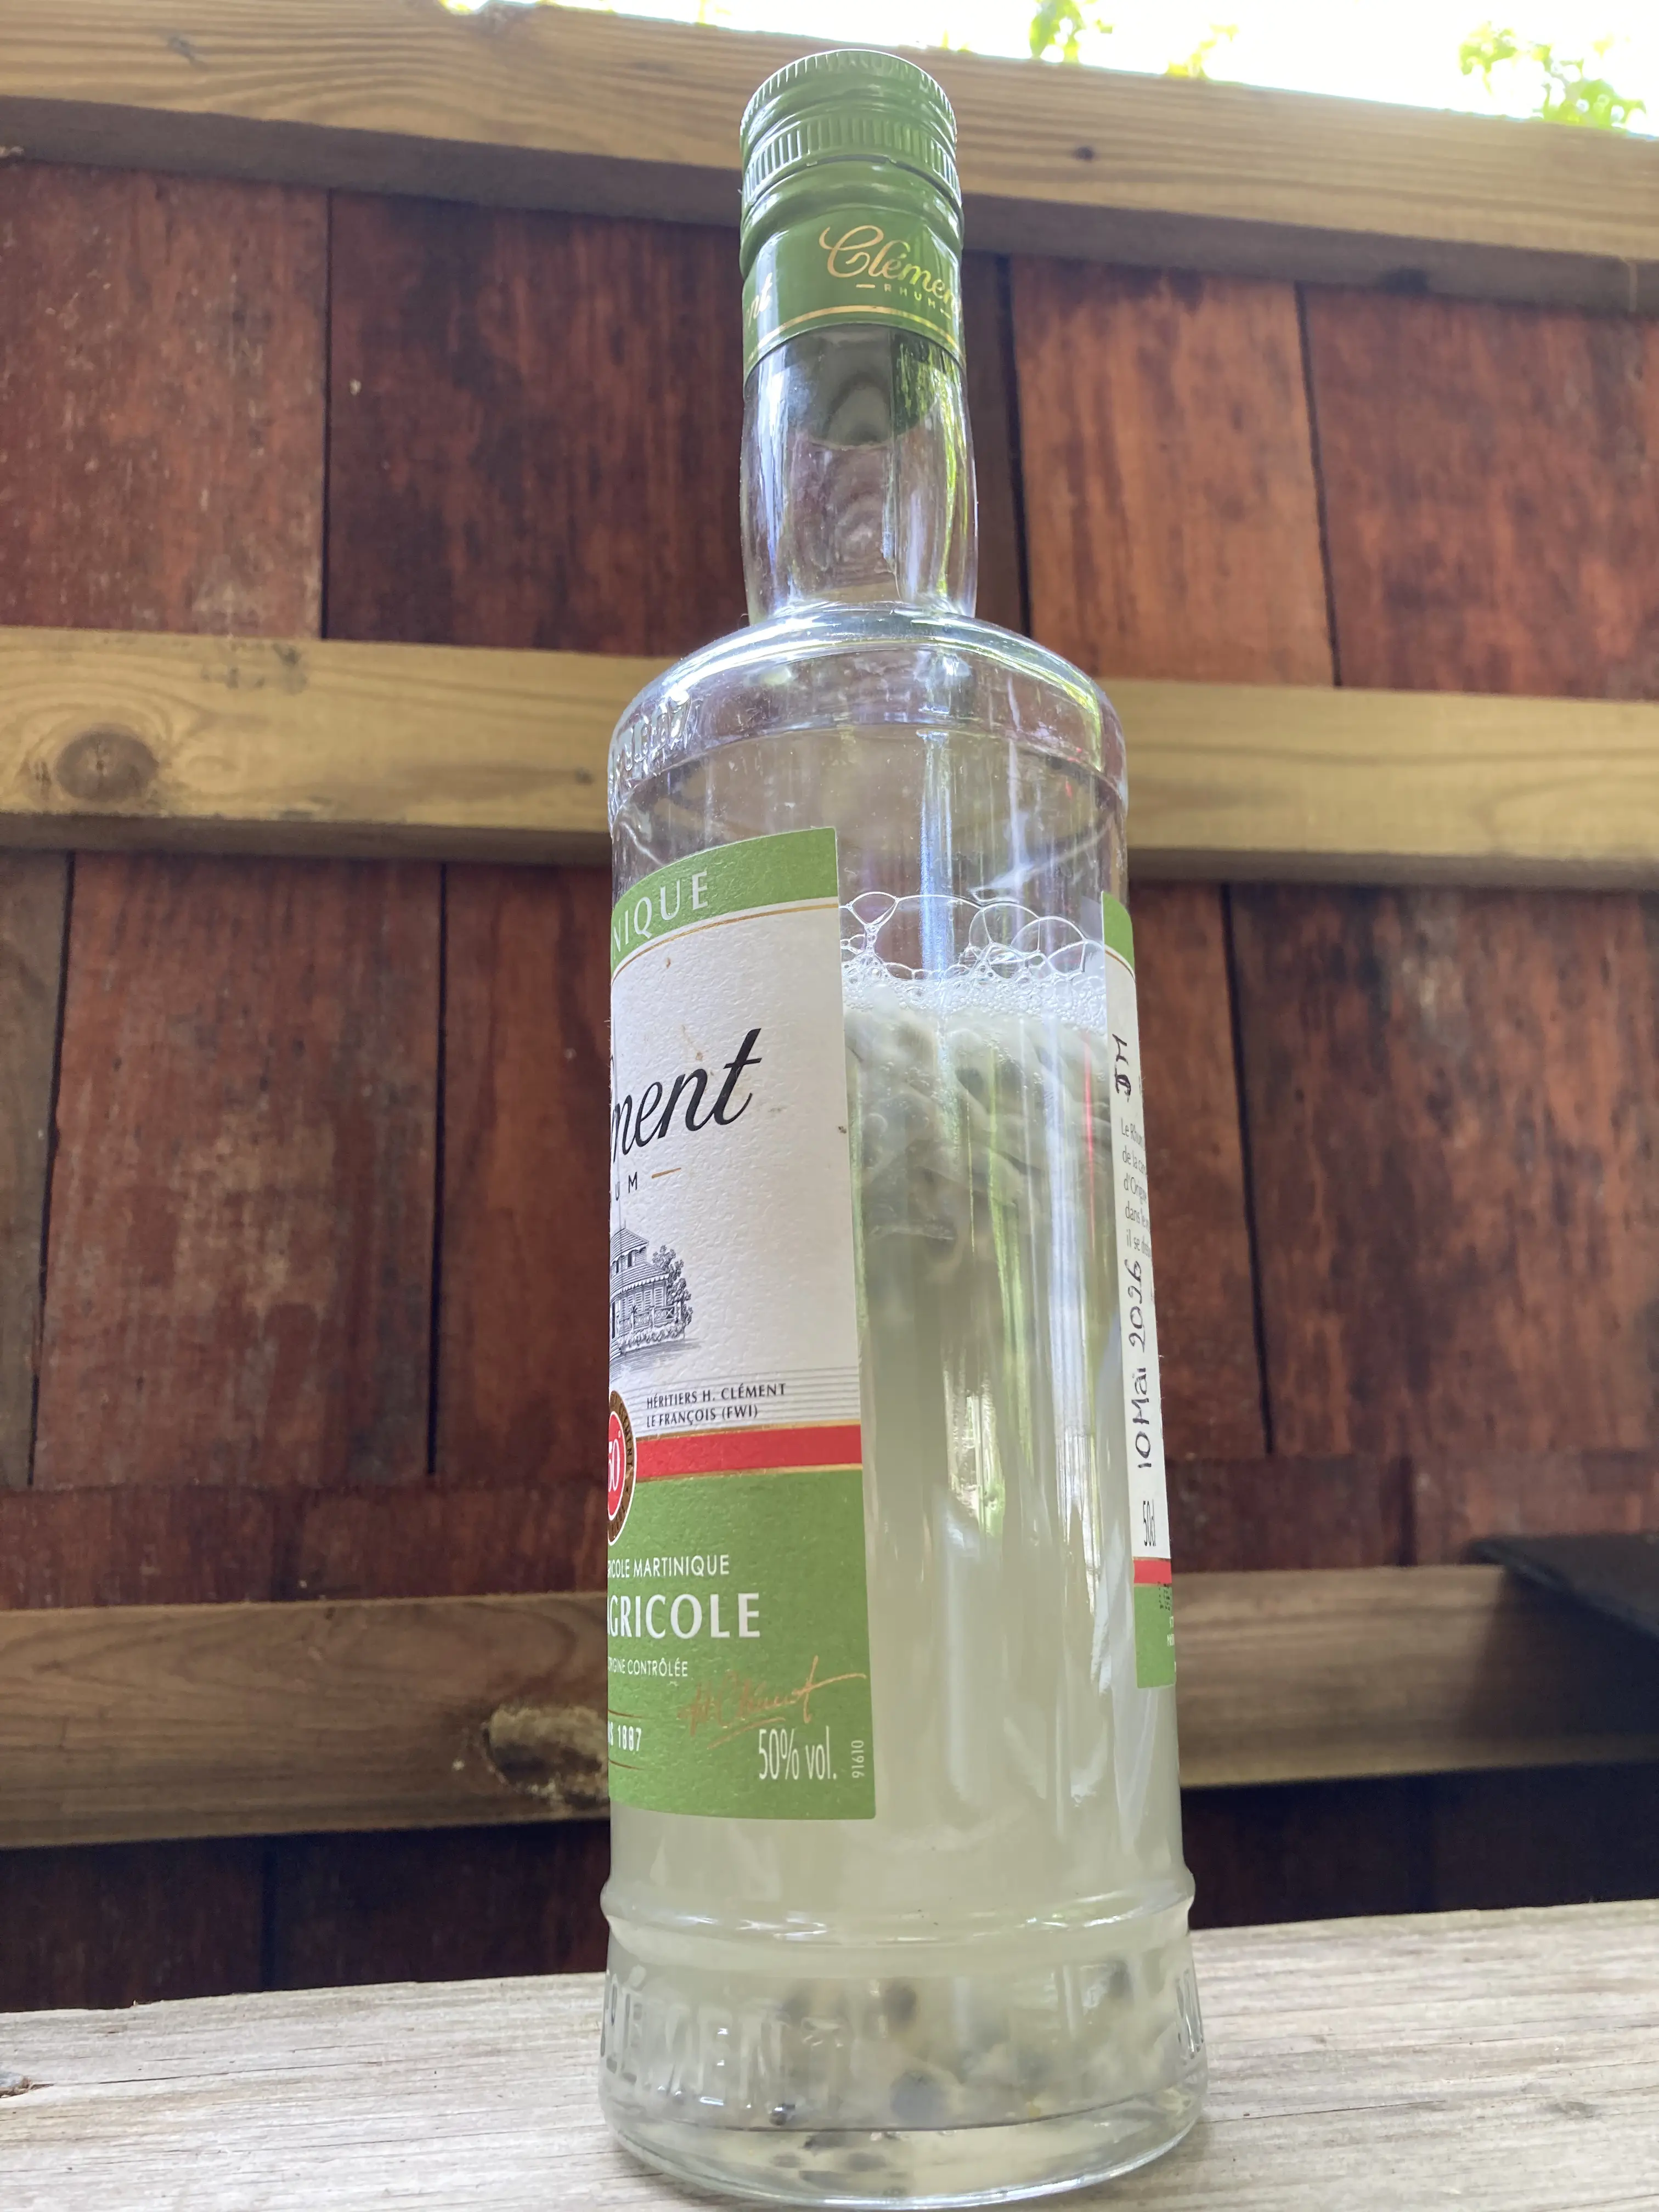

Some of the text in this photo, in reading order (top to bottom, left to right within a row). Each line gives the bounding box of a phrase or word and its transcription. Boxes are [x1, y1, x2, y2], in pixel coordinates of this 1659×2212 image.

[884, 283, 936, 309] RHUM
[613, 870, 709, 952] NIQUE
[1122, 1144, 1131, 1165] de
[1125, 1200, 1141, 1224] dans
[1126, 1228, 1132, 1248] il
[1133, 1237, 1141, 1251] se
[646, 1383, 786, 1409] HÉRITIERS H. CLÉMENT
[646, 1403, 758, 1428] LE FRANÇOIS (FWI)
[634, 1554, 730, 1578] MARTINIQUE
[627, 1657, 689, 1678] CONTRÔLÉE
[618, 1724, 642, 1752] 1887
[759, 1725, 837, 1781] 50% vol.
[851, 1739, 865, 1779] 91610
